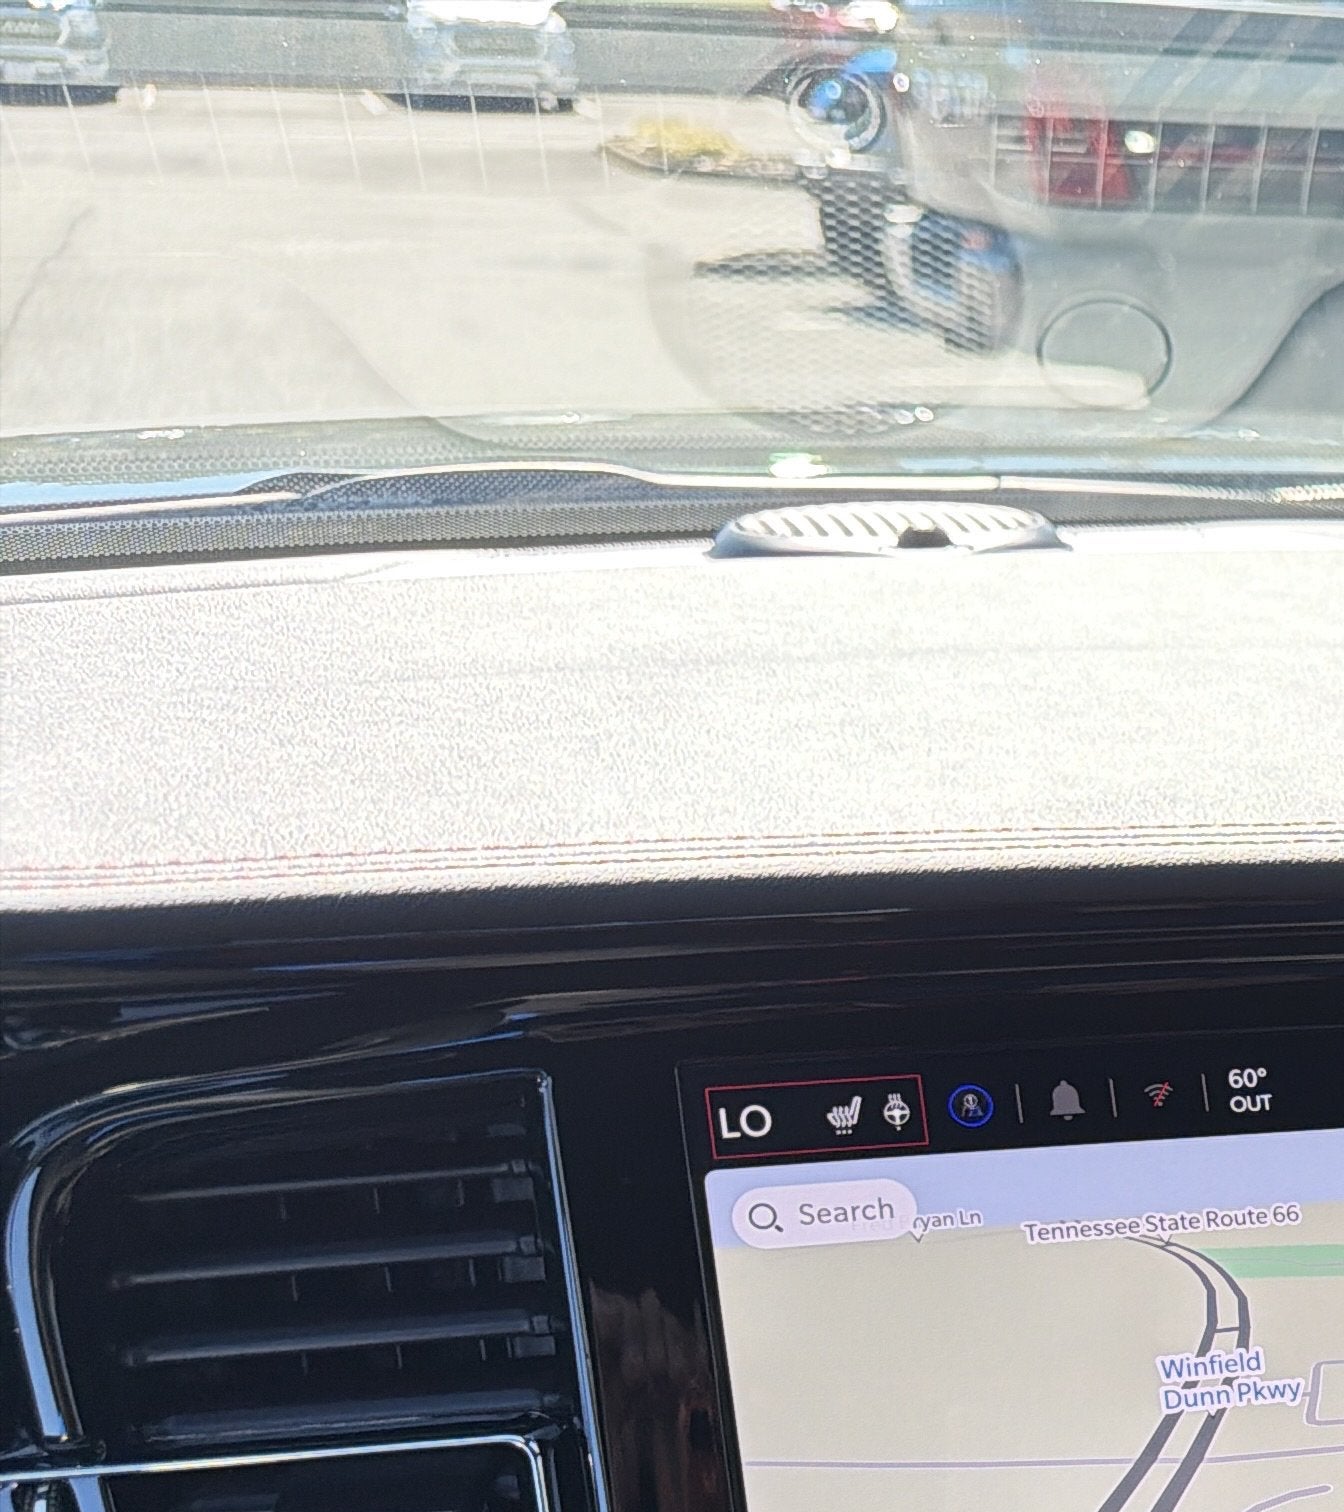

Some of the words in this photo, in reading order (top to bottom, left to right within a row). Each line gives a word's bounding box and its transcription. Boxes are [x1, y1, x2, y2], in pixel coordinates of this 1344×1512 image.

[1230, 1094, 1272, 1113] OUT
[718, 1105, 771, 1140] LO
[799, 1198, 894, 1226] Search
[959, 1211, 981, 1226] Ln
[1025, 1217, 1140, 1242] Tennessee
[1144, 1211, 1200, 1234] State
[1205, 1208, 1266, 1231] Route
[1273, 1206, 1299, 1224] 66
[1160, 1351, 1262, 1379] Winfield
[1164, 1385, 1231, 1411] Dunn
[1238, 1379, 1301, 1405] Pkwy
